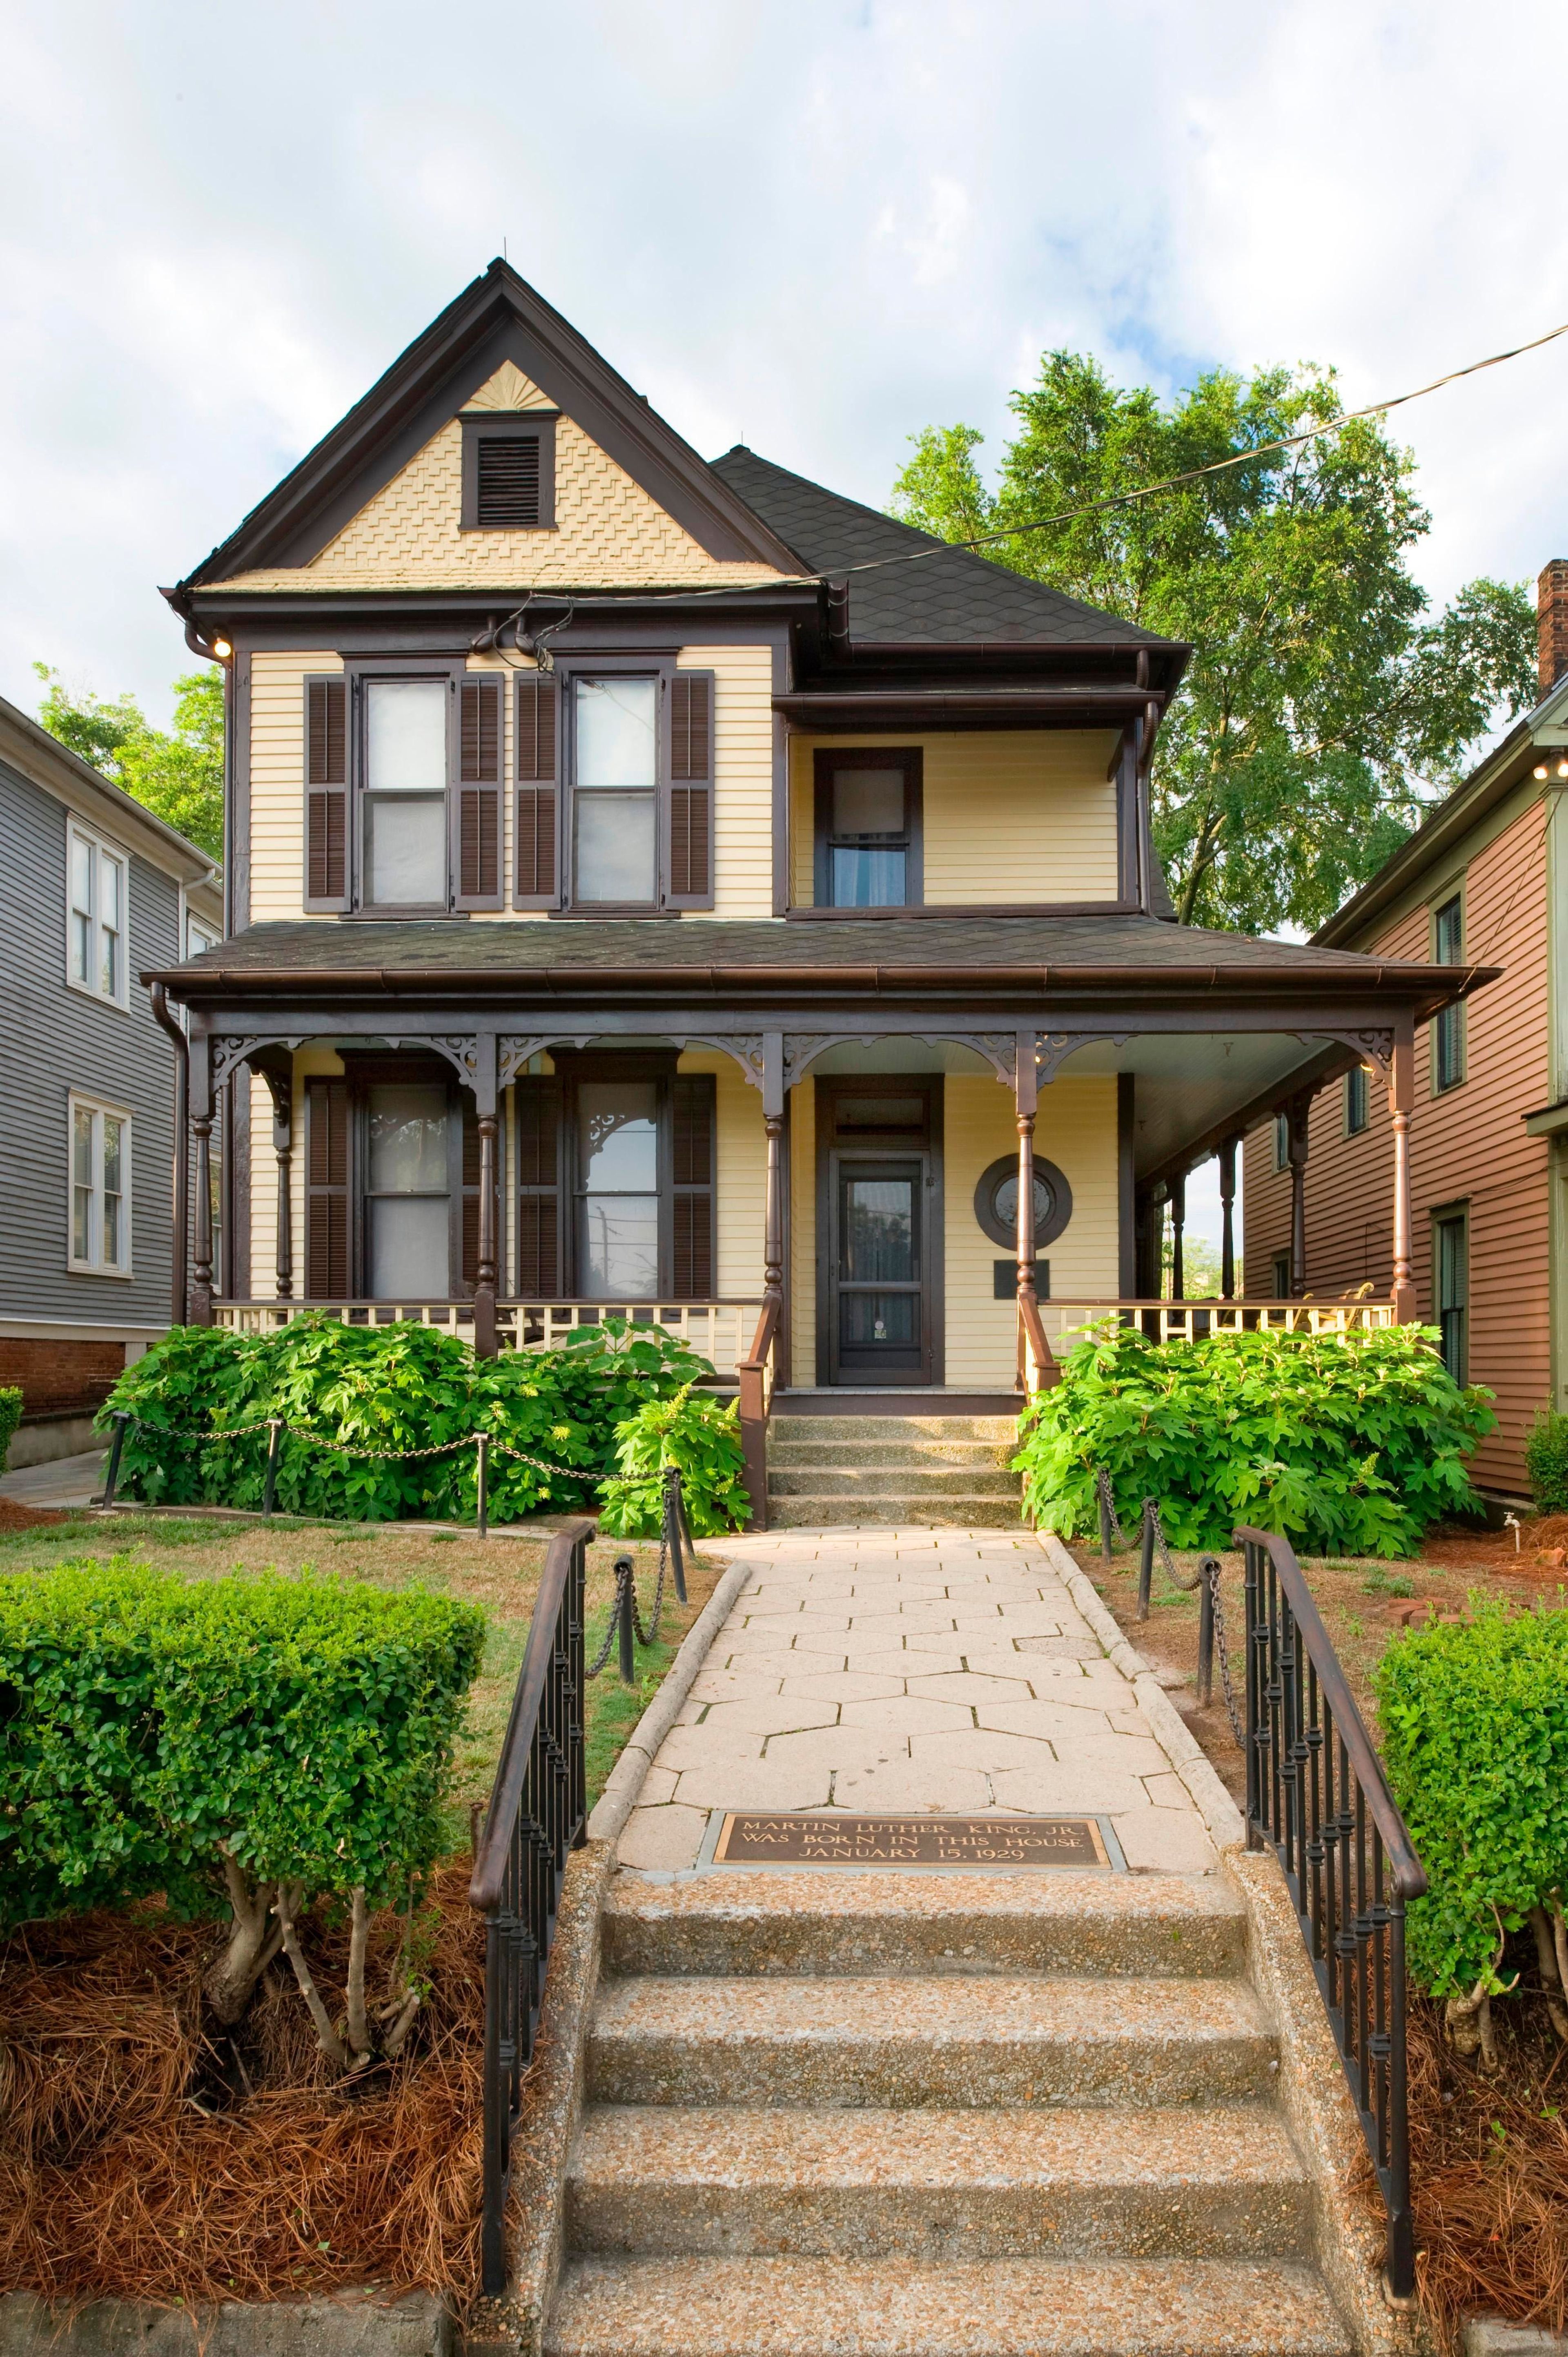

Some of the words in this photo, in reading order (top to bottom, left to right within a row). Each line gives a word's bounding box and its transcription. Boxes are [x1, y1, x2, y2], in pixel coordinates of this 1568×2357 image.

[742, 1822, 841, 1831] MARTIN
[855, 1824, 953, 1833] LUTHER
[1045, 1826, 1085, 1835] JR.
[741, 1833, 789, 1842] WAS
[802, 1835, 877, 1844] BORN
[890, 1836, 920, 1845] IN
[933, 1836, 989, 1846] THIS
[1005, 1838, 1084, 1848] HOUSE
[799, 1848, 922, 1858] JANUARY
[976, 1849, 1025, 1861] 1929
